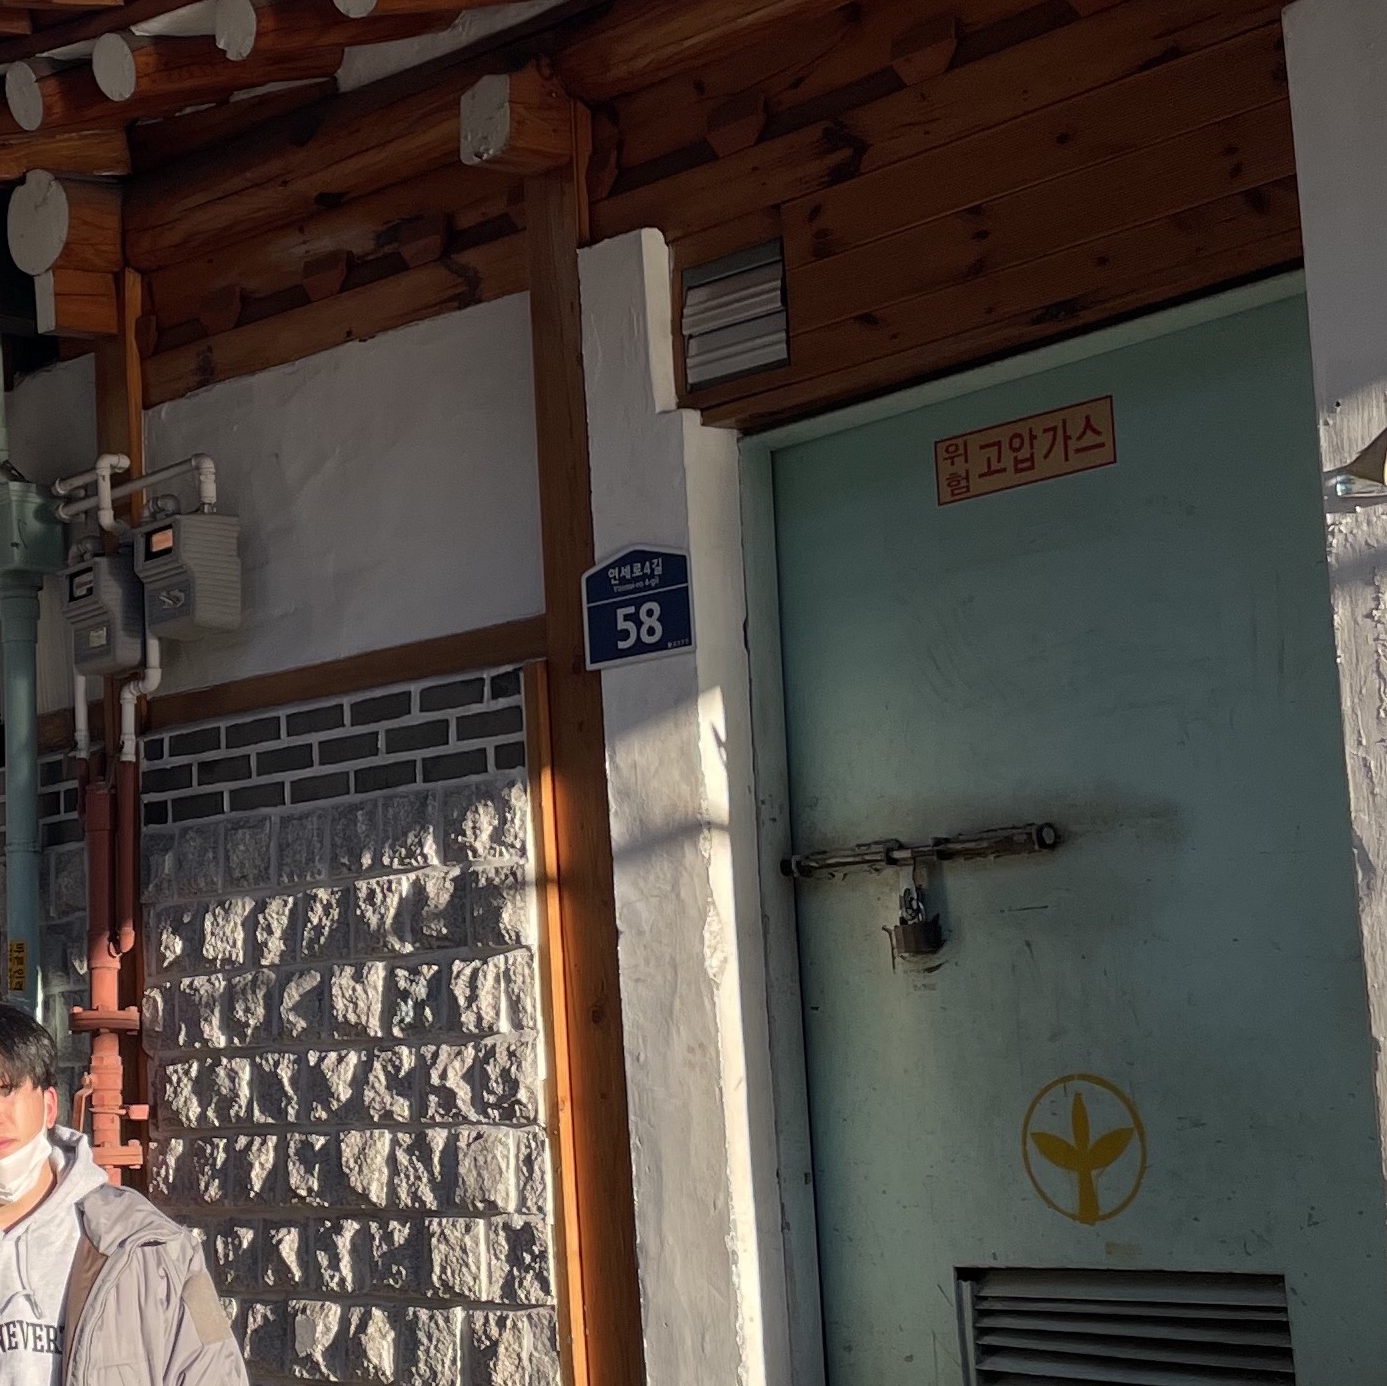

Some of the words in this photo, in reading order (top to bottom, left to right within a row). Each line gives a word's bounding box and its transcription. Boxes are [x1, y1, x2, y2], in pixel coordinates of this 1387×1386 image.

[942, 439, 971, 498] 위험
[977, 414, 1107, 479] 고압가스
[616, 601, 663, 650] 58
